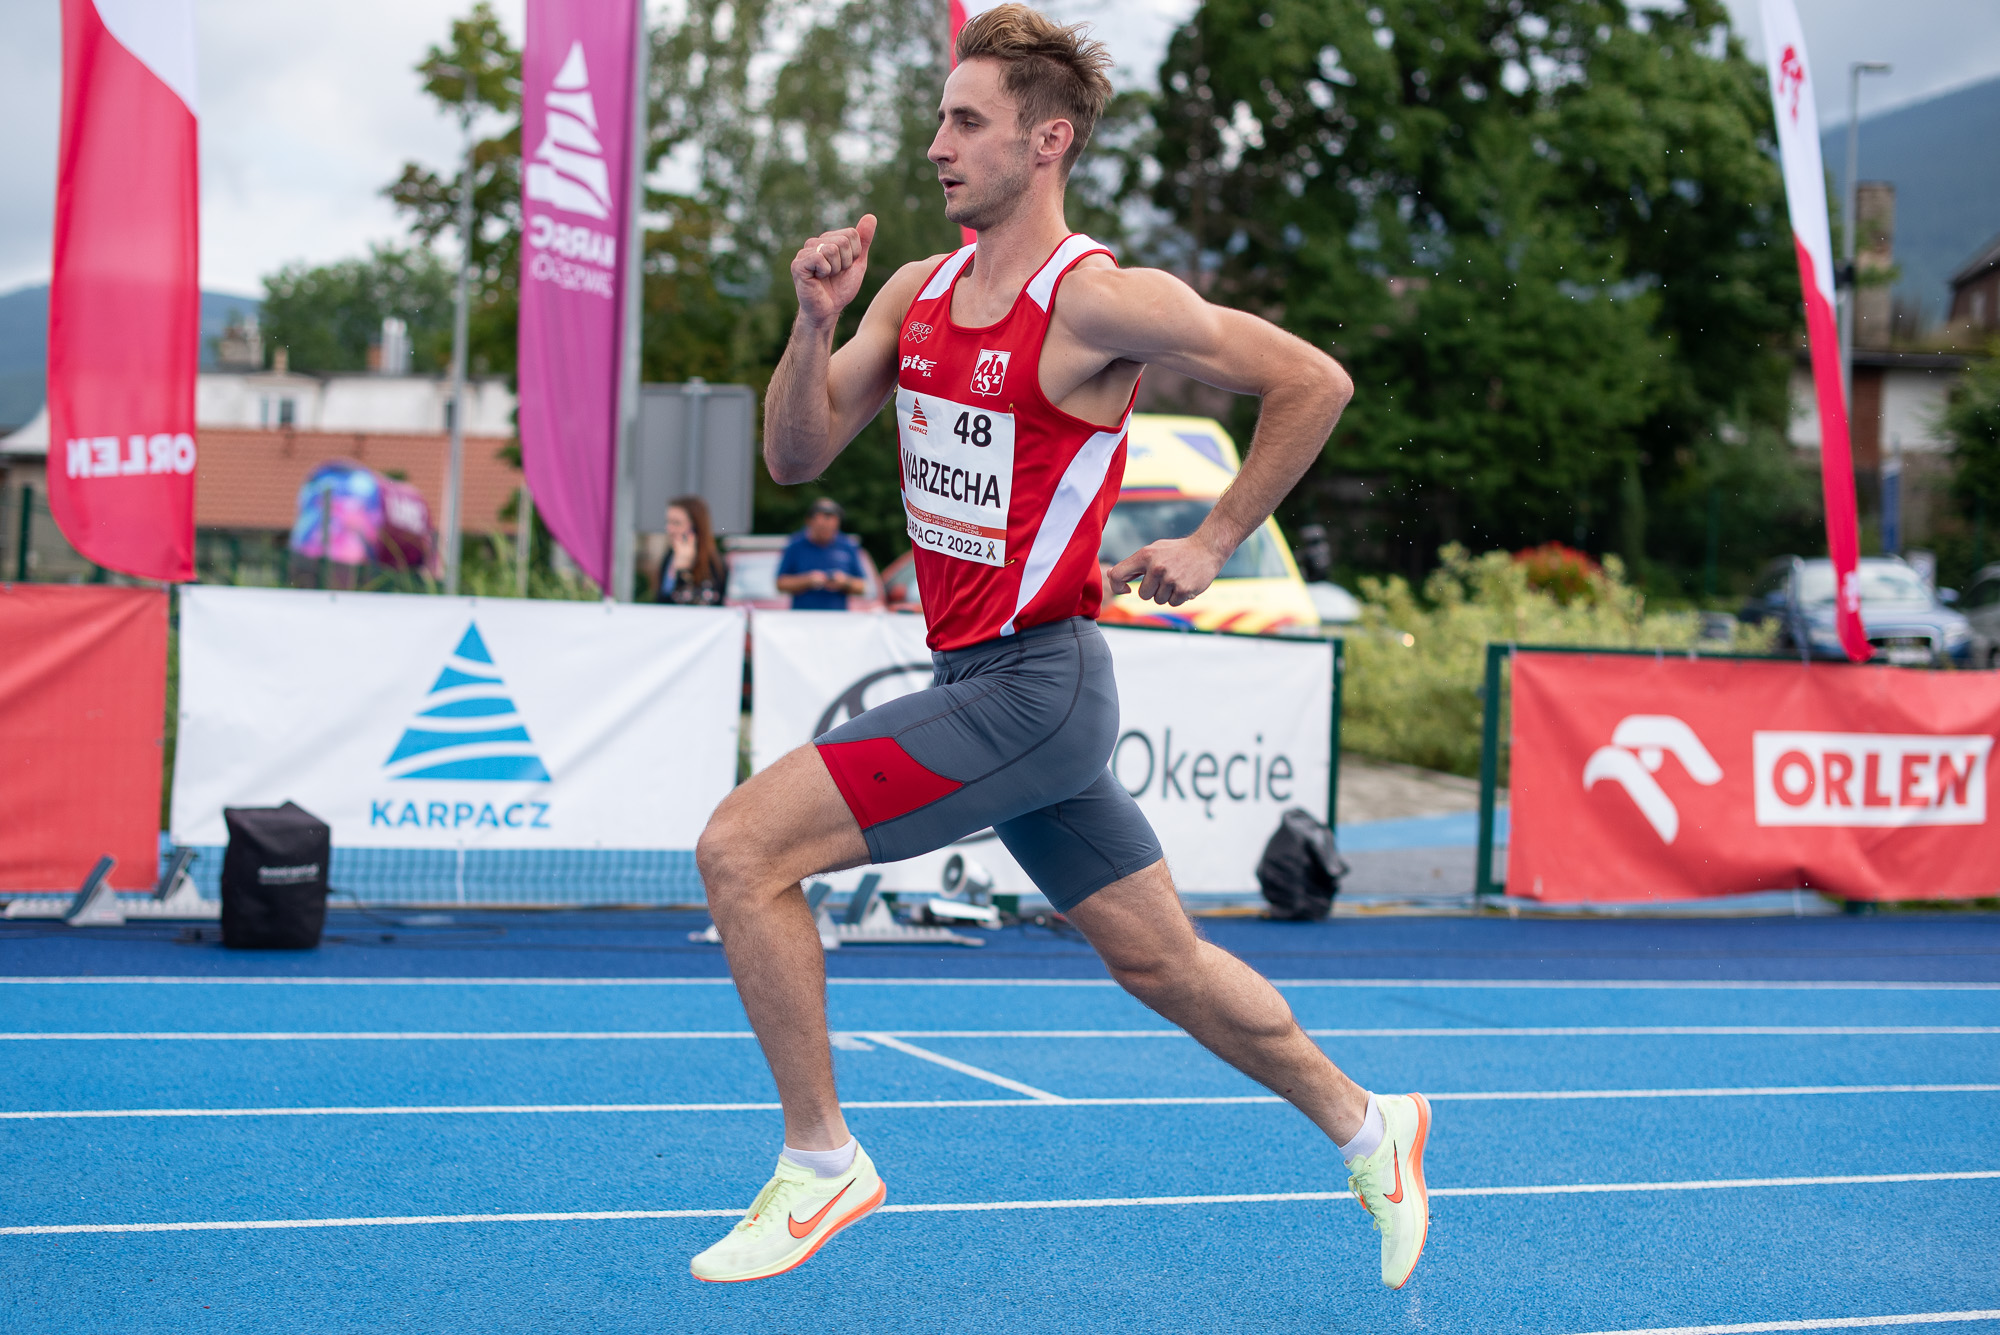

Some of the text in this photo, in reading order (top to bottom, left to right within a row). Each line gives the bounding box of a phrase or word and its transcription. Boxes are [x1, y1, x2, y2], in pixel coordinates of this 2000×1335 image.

[908, 424, 928, 436] KARPACZ
[953, 411, 992, 448] 48
[902, 447, 1001, 509] WARZECHA
[906, 515, 944, 547] ARPACZ
[947, 535, 983, 557] 2022
[1112, 727, 1293, 819] Okęcie
[1772, 749, 1977, 807] ORLEN
[370, 800, 552, 829] KARPACZ
